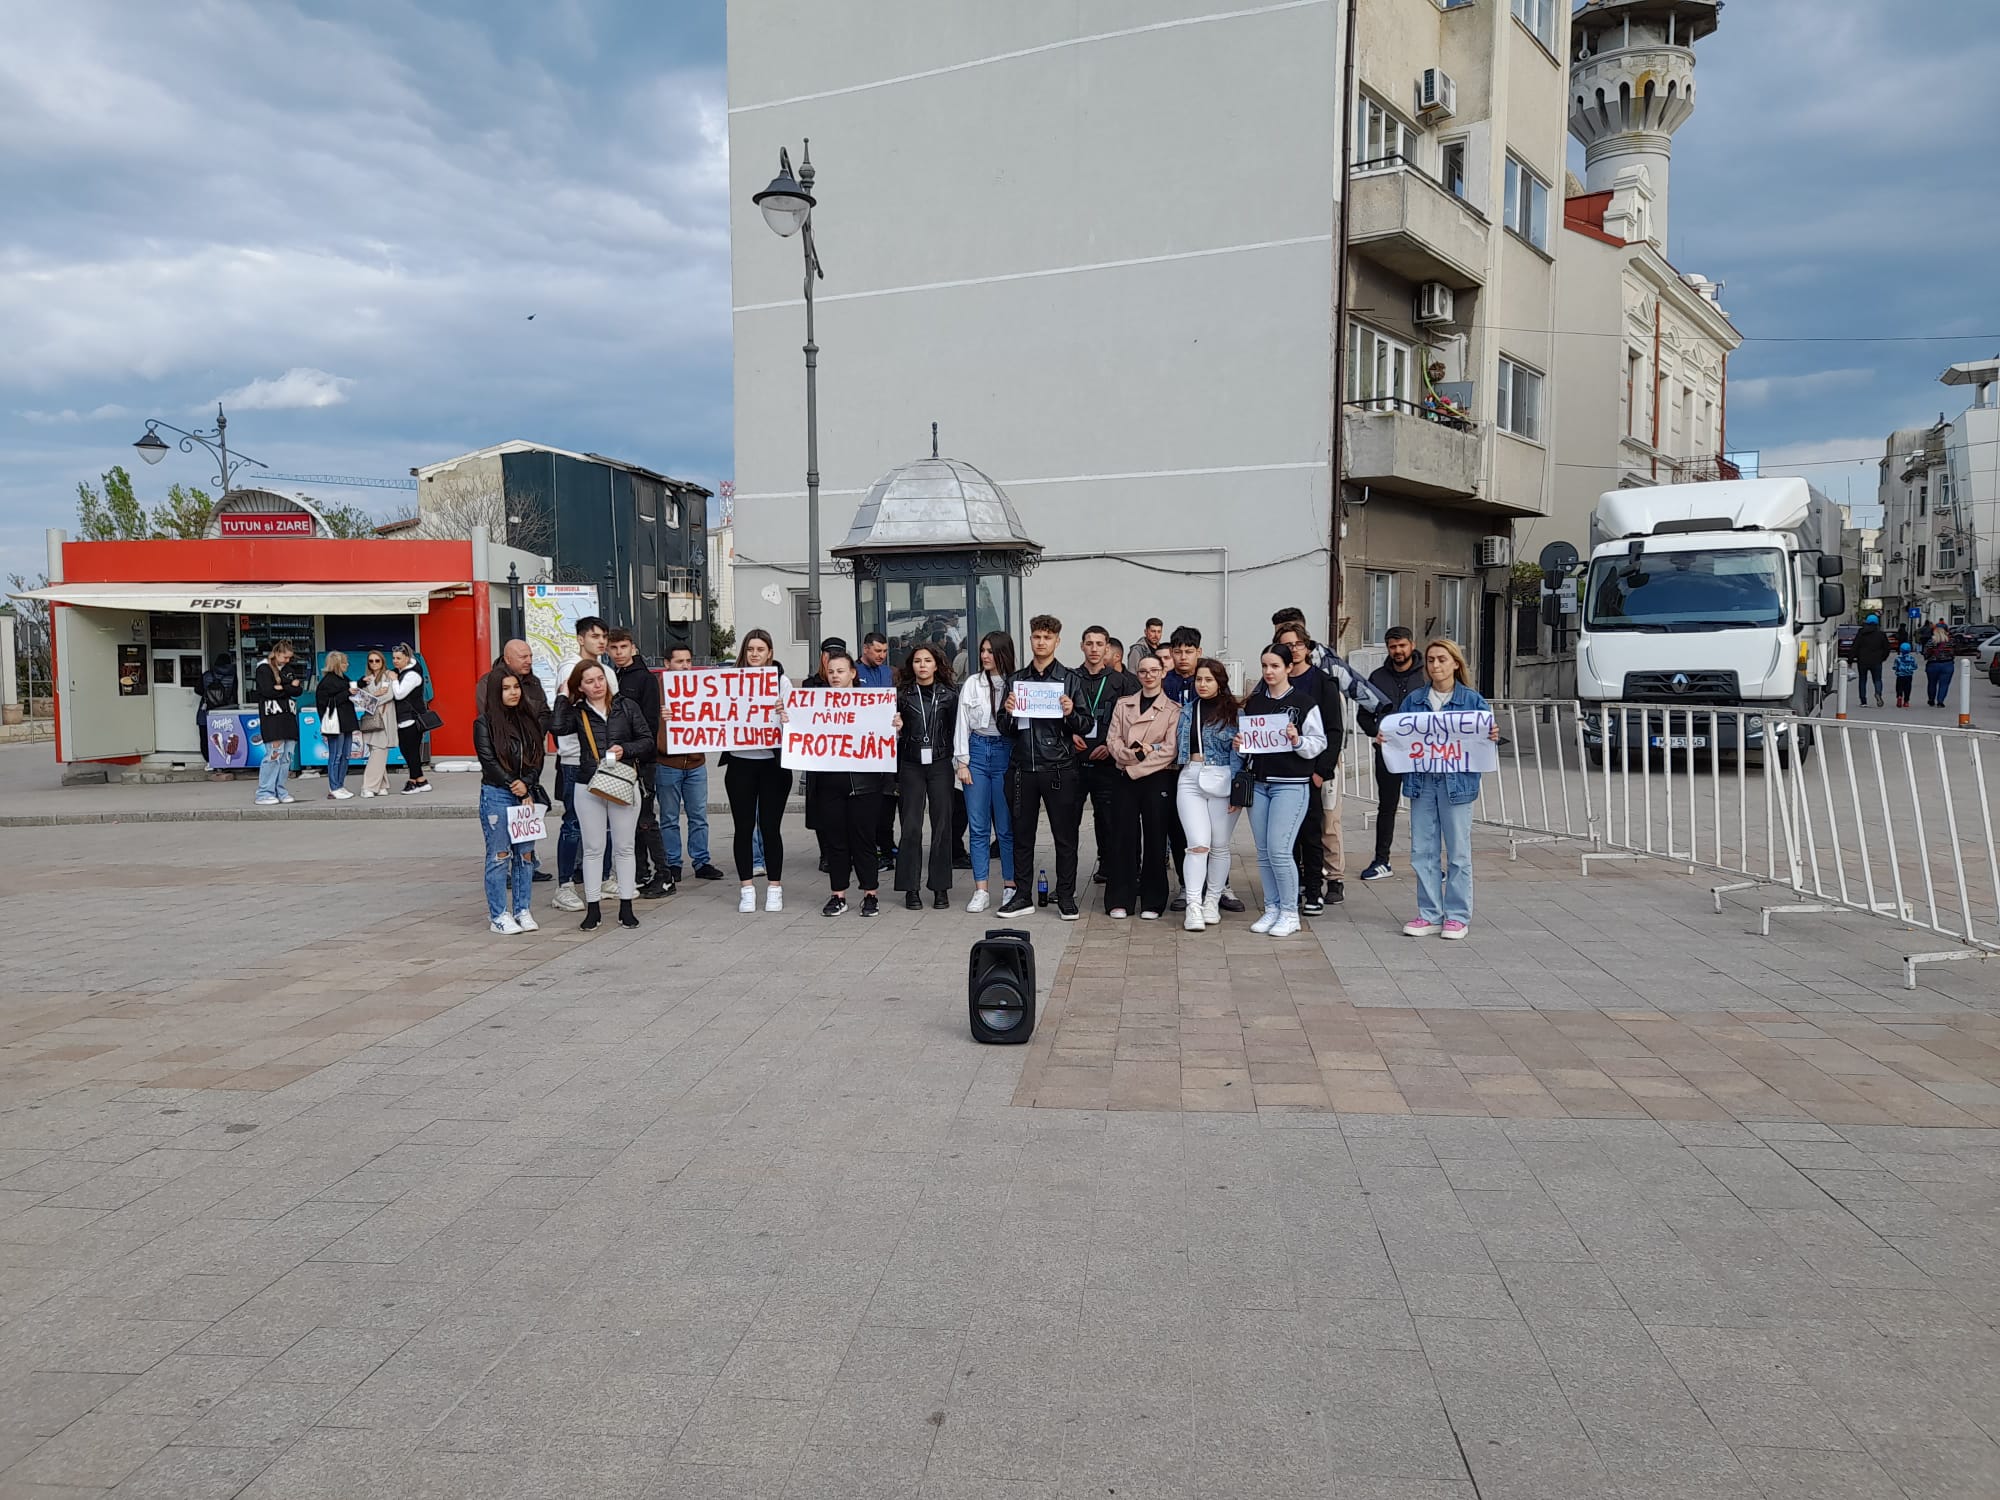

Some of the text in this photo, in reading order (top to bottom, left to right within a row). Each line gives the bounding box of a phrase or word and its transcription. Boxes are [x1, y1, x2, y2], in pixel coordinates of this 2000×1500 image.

[223, 521, 261, 531] TUTUN
[276, 521, 309, 531] ZIARE
[189, 599, 242, 609] PEPSI
[787, 690, 815, 708] AZI
[1014, 697, 1032, 711] NU
[670, 697, 738, 722] EGALĂ
[1250, 717, 1266, 728] NO
[1396, 711, 1492, 736] SUNTEM
[669, 724, 782, 747] TOATĂ LUMEA
[1243, 728, 1288, 750] DRUGS
[1424, 731, 1449, 746] CU
[788, 731, 896, 760] PROTEJĂM
[1409, 742, 1425, 759] 2
[517, 807, 531, 819] NO
[511, 817, 541, 839] DRUGS
